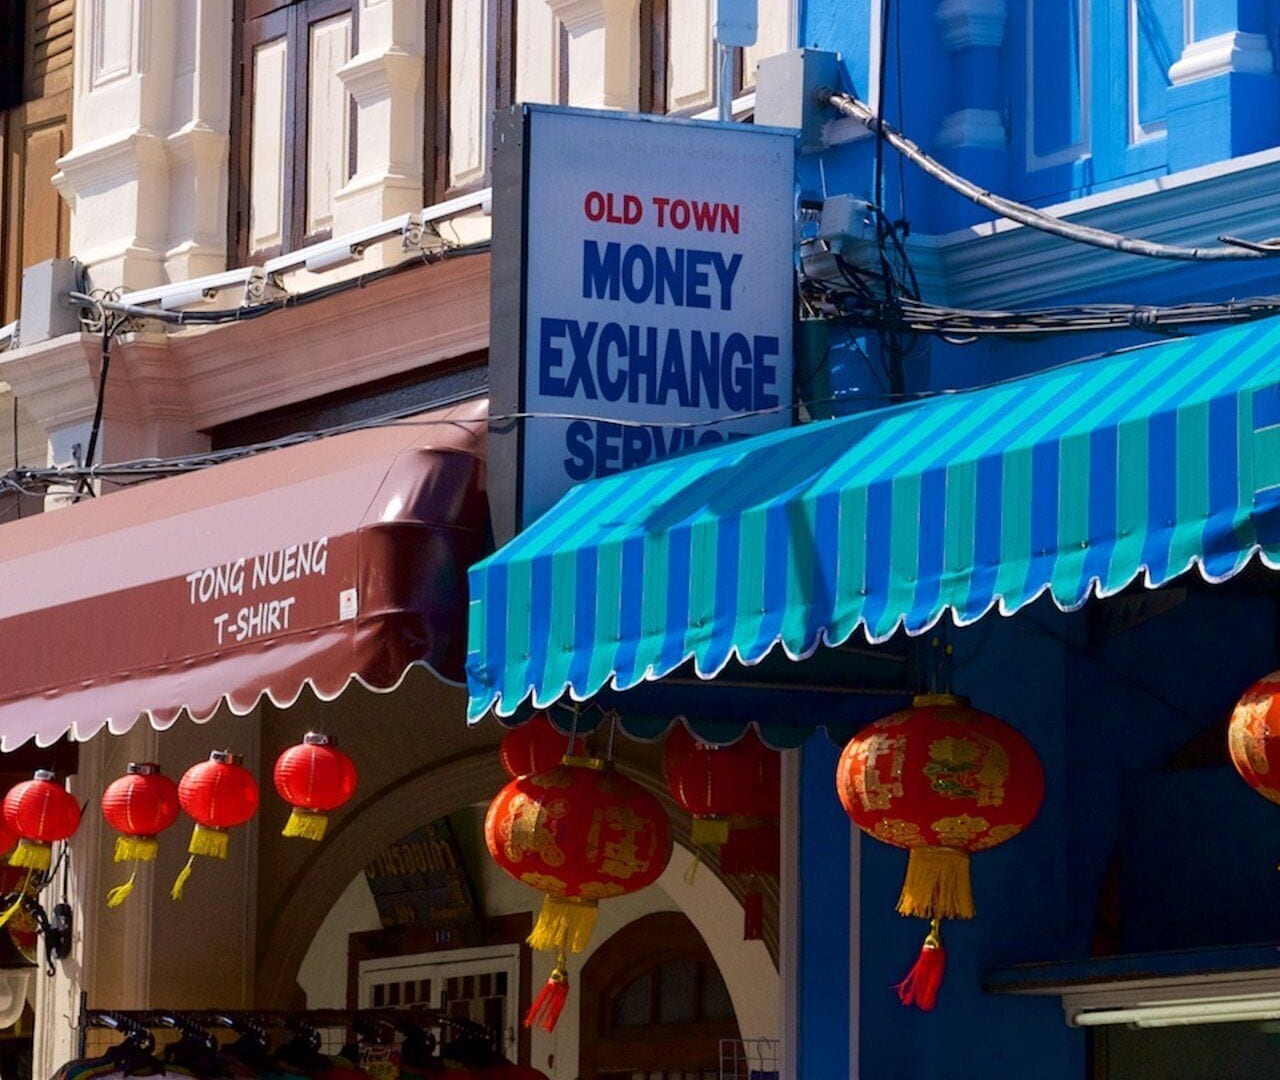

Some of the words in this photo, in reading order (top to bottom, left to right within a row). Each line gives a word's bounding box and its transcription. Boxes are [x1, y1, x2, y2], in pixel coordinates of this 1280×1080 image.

[584, 191, 644, 225] OLD
[652, 197, 741, 234] TOWN
[582, 240, 743, 310] MONEY
[539, 318, 780, 412] EXCHANGE
[564, 420, 753, 481] SERV
[186, 557, 246, 604] TONG
[252, 536, 328, 589] NUENG
[214, 597, 296, 645] T-SHIRT
